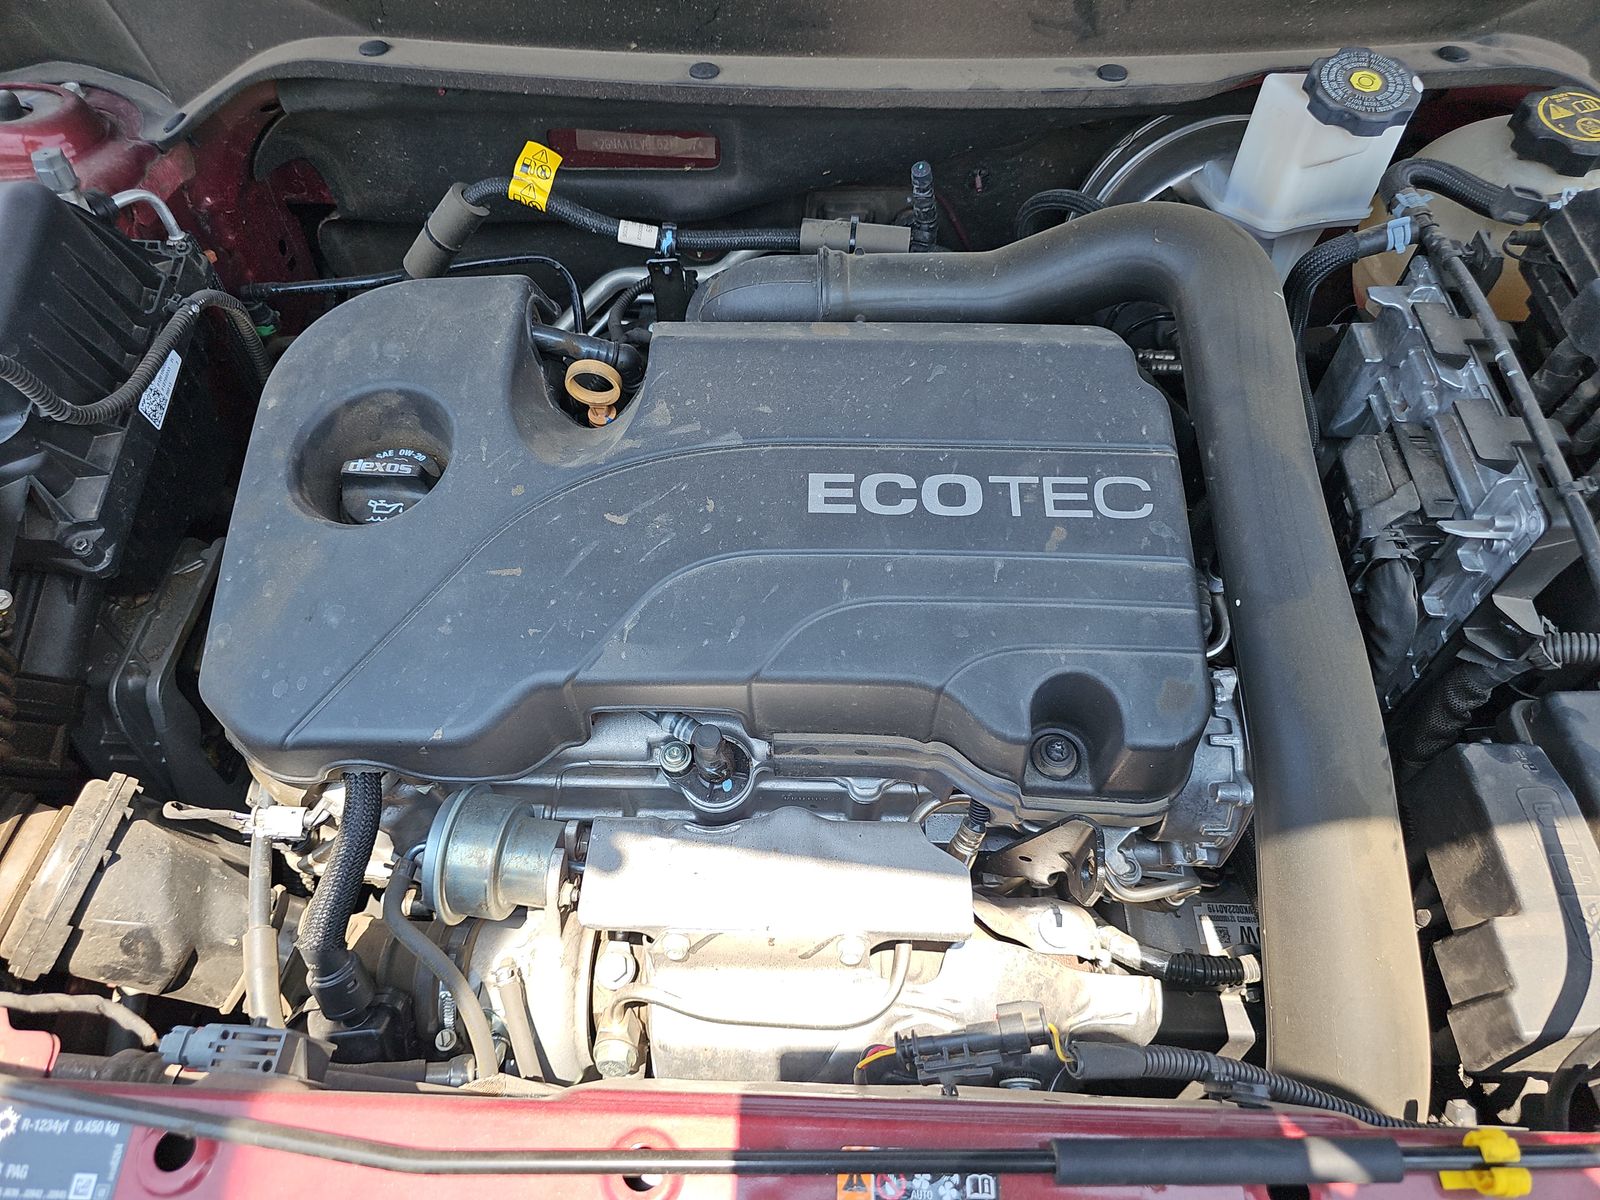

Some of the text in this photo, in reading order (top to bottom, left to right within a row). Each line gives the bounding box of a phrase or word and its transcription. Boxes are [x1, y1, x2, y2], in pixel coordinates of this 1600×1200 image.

[376, 449, 427, 462] SAE 0W-20
[347, 459, 413, 474] dexos
[808, 472, 1154, 520] ECOTEC
[104, 1120, 120, 1138] kg
[5, 1163, 29, 1180] PAG
[911, 1189, 932, 1200] AUTO
